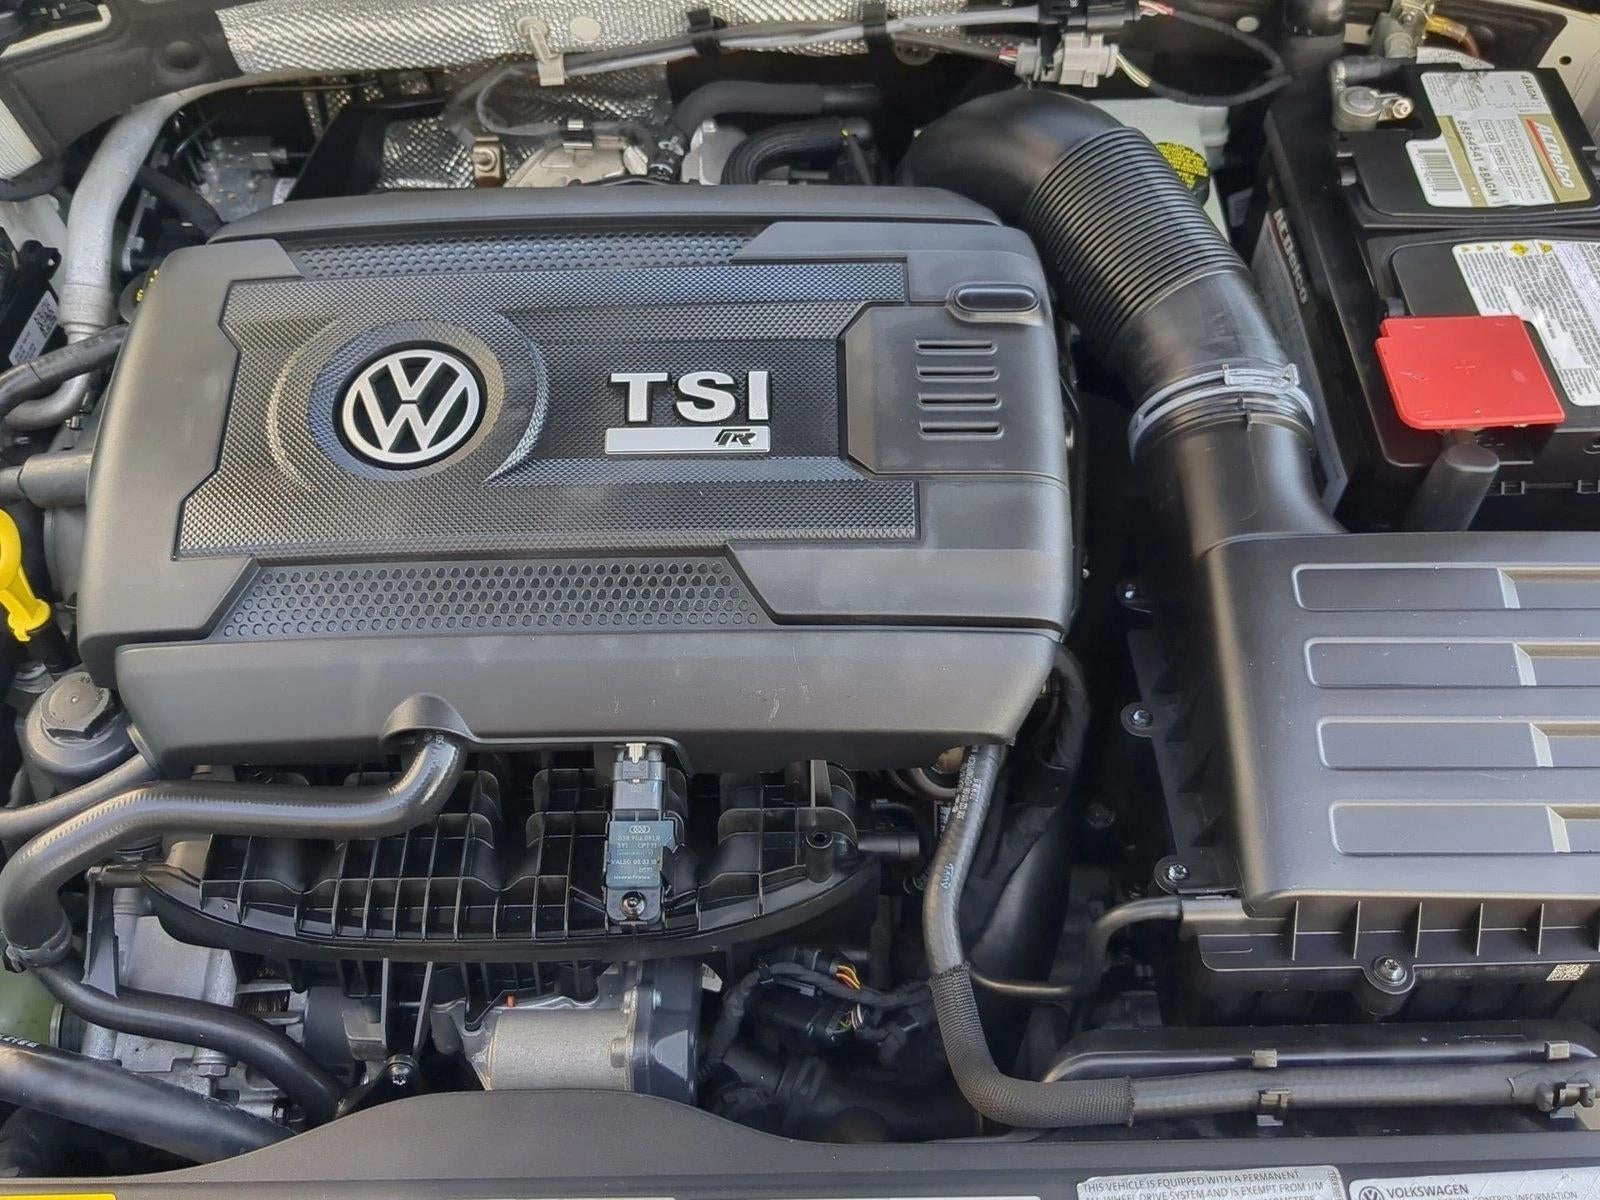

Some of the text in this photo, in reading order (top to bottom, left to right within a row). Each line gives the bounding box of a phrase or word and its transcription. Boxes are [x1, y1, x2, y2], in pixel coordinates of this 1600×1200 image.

[1534, 121, 1575, 189] ACDelco
[610, 370, 769, 423] TSI
[1084, 1171, 1300, 1193] THIS VEHICLE IS EQUIPPED WITH A PERMANENT
[1139, 1192, 1167, 1200] DRIVE
[1170, 1190, 1204, 1200] SYSTEM
[1207, 1187, 1228, 1198] AND
[1230, 1186, 1239, 1196] IS
[1242, 1184, 1277, 1196] EXEMPT
[1280, 1182, 1304, 1193] FROM
[1386, 1184, 1469, 1198] VOLKSWAGEN
[1516, 1191, 1577, 1200] INFORMATION
